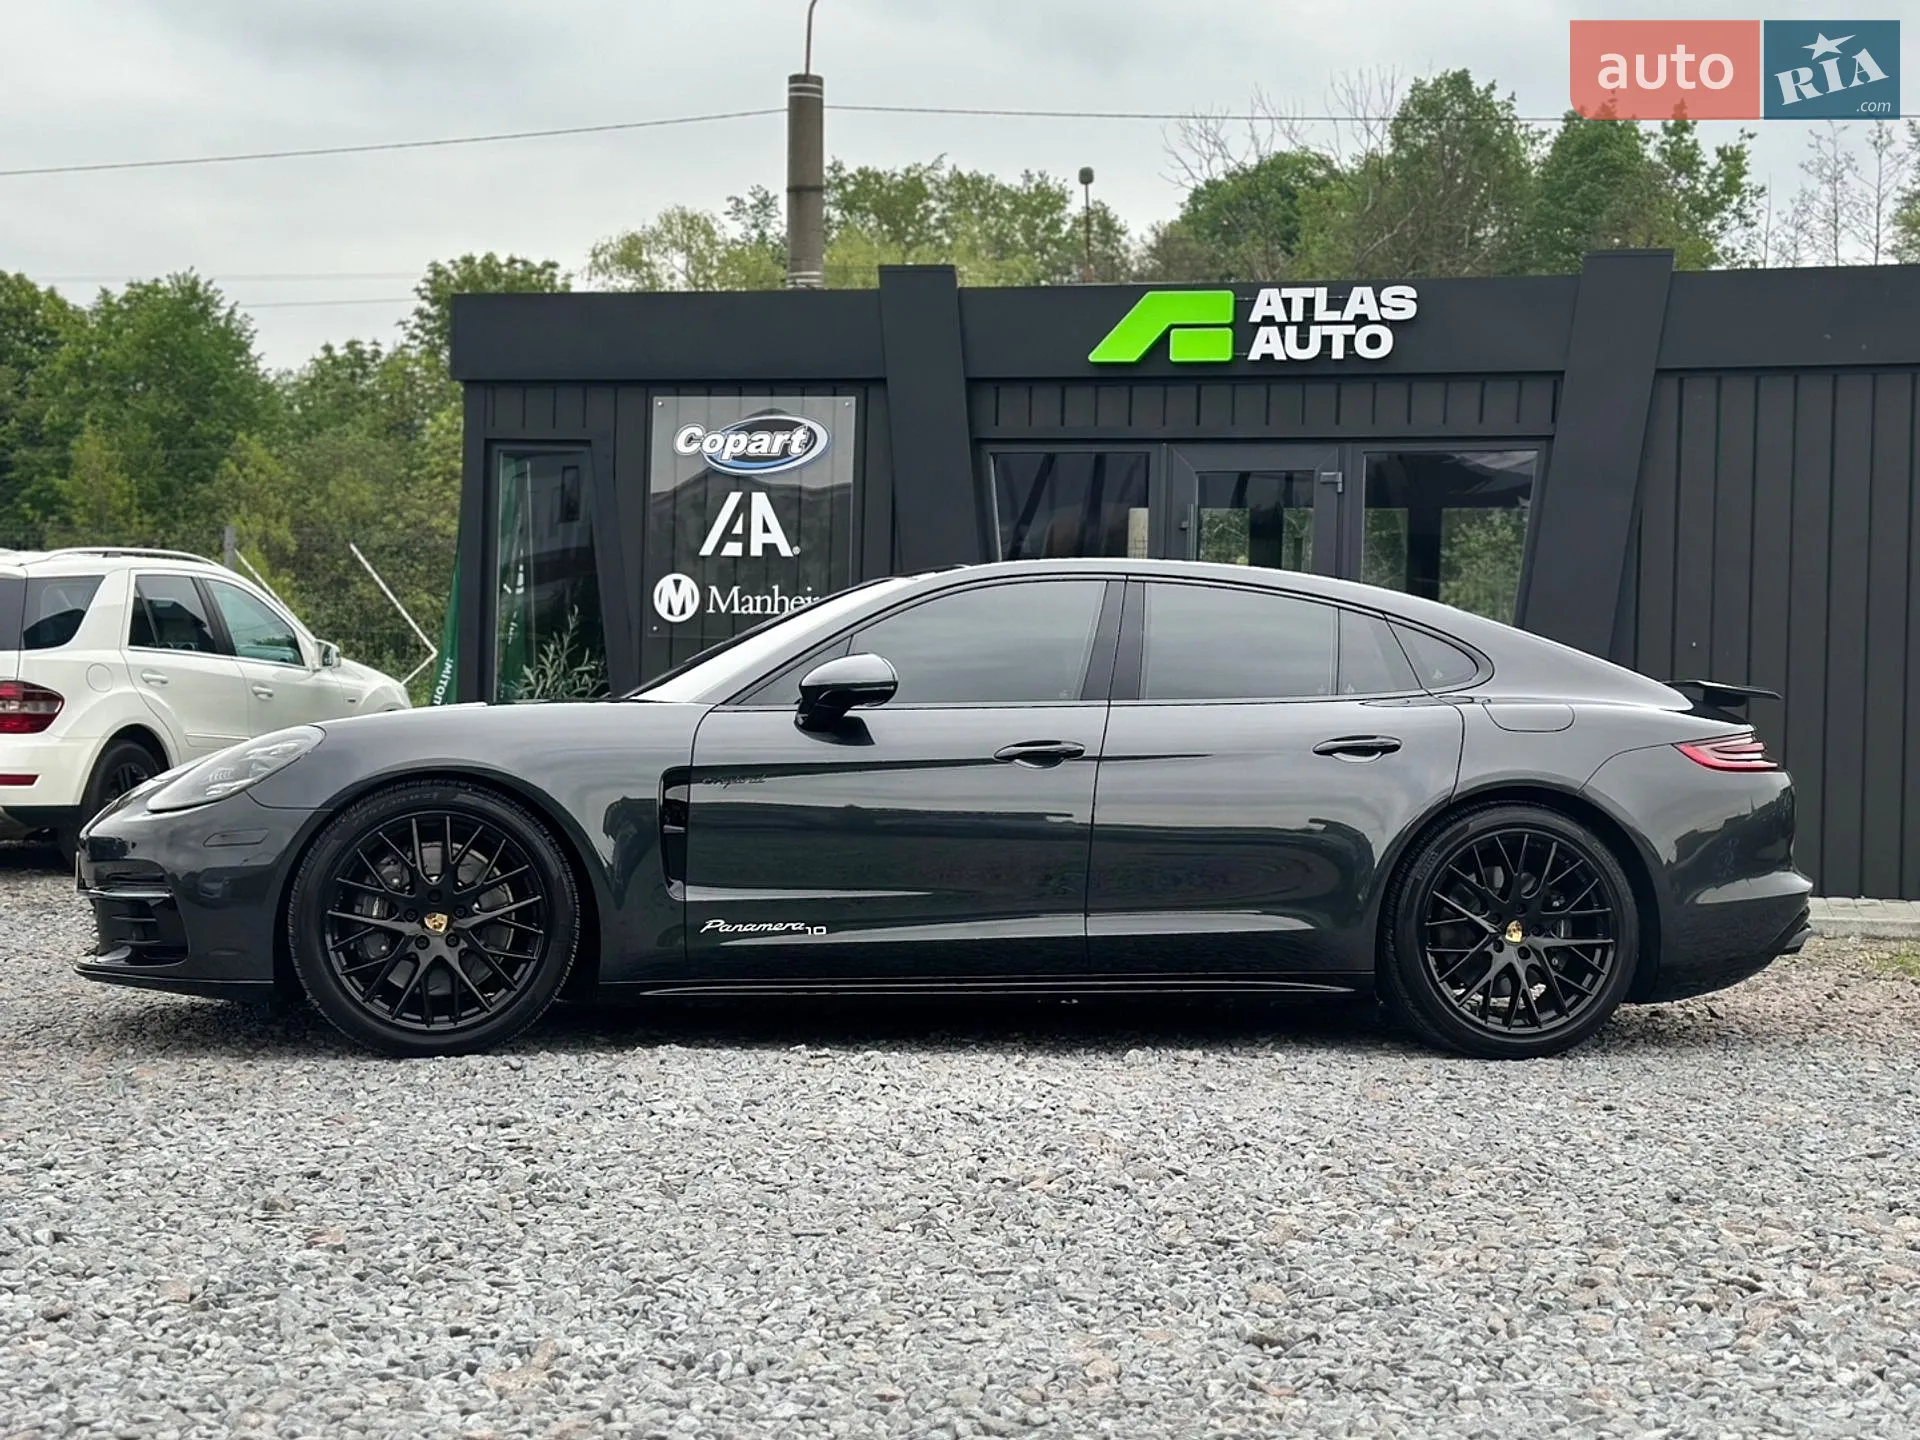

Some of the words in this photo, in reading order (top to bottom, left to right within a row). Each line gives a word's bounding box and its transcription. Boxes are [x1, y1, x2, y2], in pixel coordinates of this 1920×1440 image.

[1248, 285, 1418, 323] ATLAS
[1247, 324, 1394, 361] AUTO
[674, 422, 809, 462] Copart
[706, 584, 821, 615] Manhei
[700, 919, 805, 934] Panamera
[805, 926, 827, 936] 10
